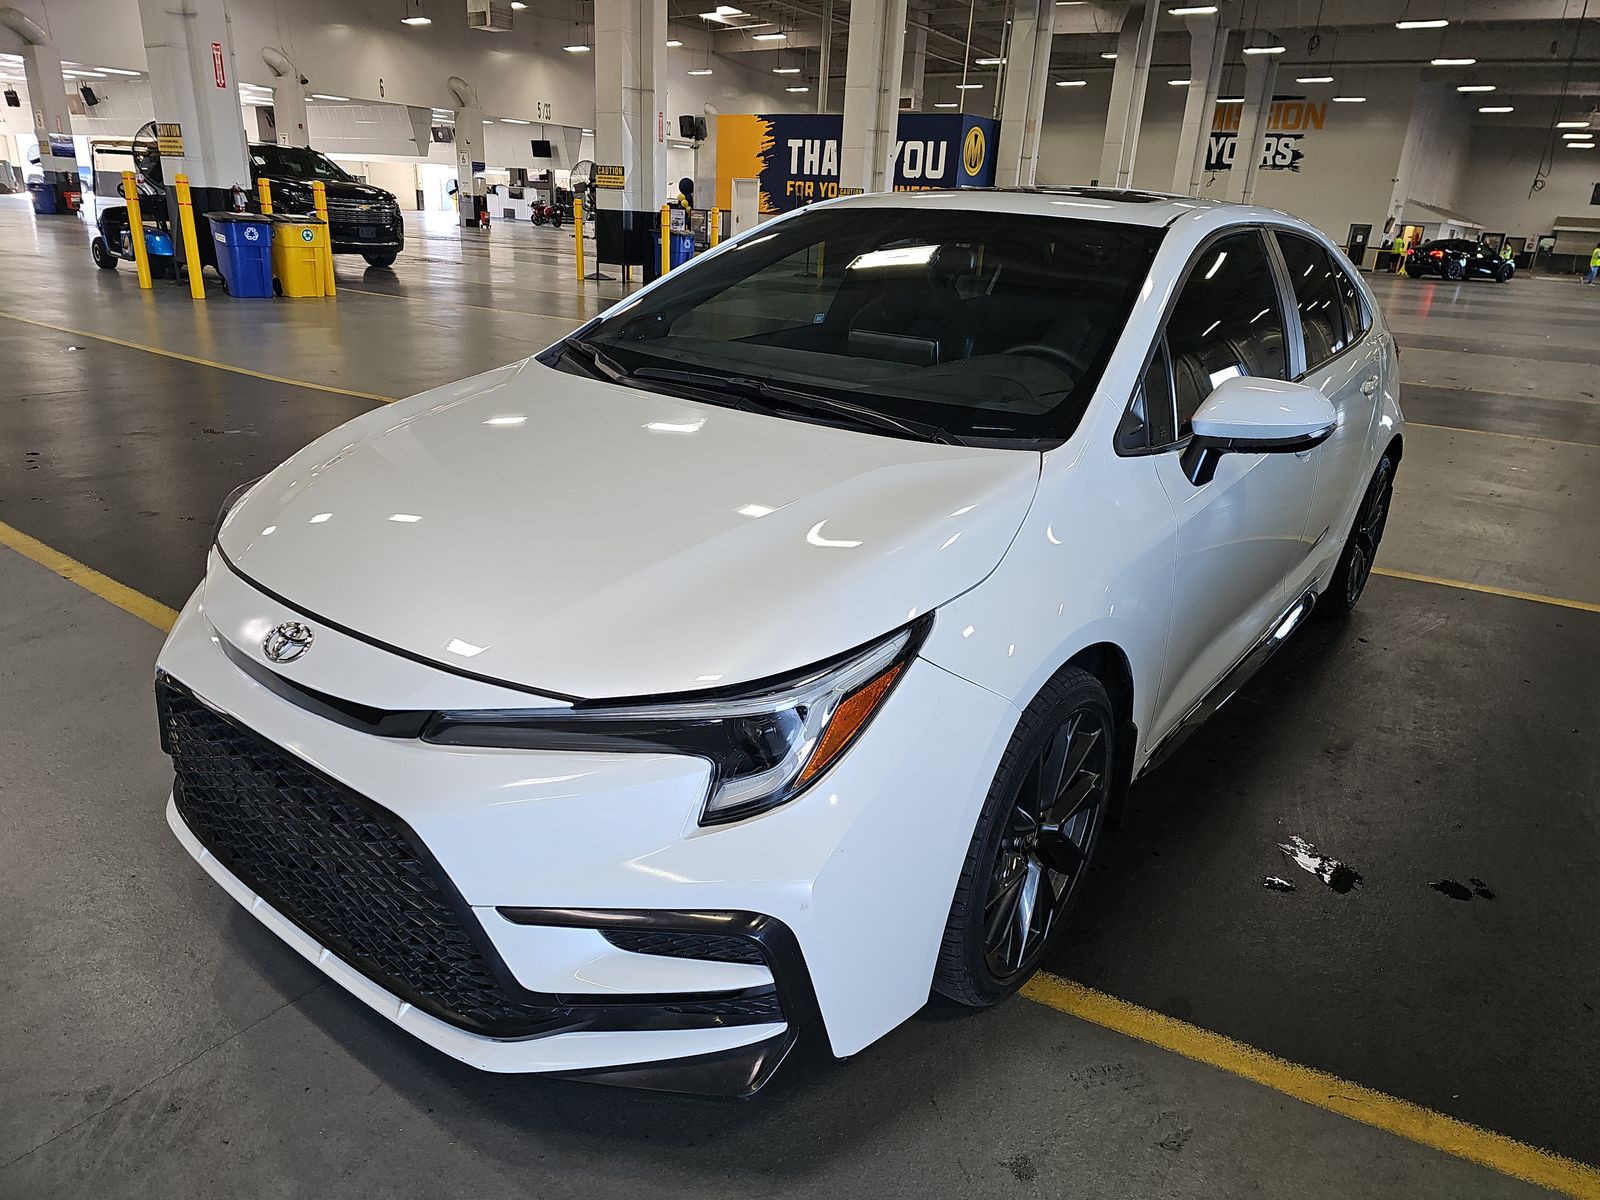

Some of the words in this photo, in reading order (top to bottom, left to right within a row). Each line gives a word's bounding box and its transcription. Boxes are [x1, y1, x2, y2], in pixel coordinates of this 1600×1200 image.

[379, 78, 385, 98] 6
[1211, 102, 1328, 130] MISION
[1208, 136, 1297, 166] YORS
[597, 166, 623, 176] CAUTION
[786, 180, 814, 197] FOR
[840, 188, 863, 196] CAUTION
